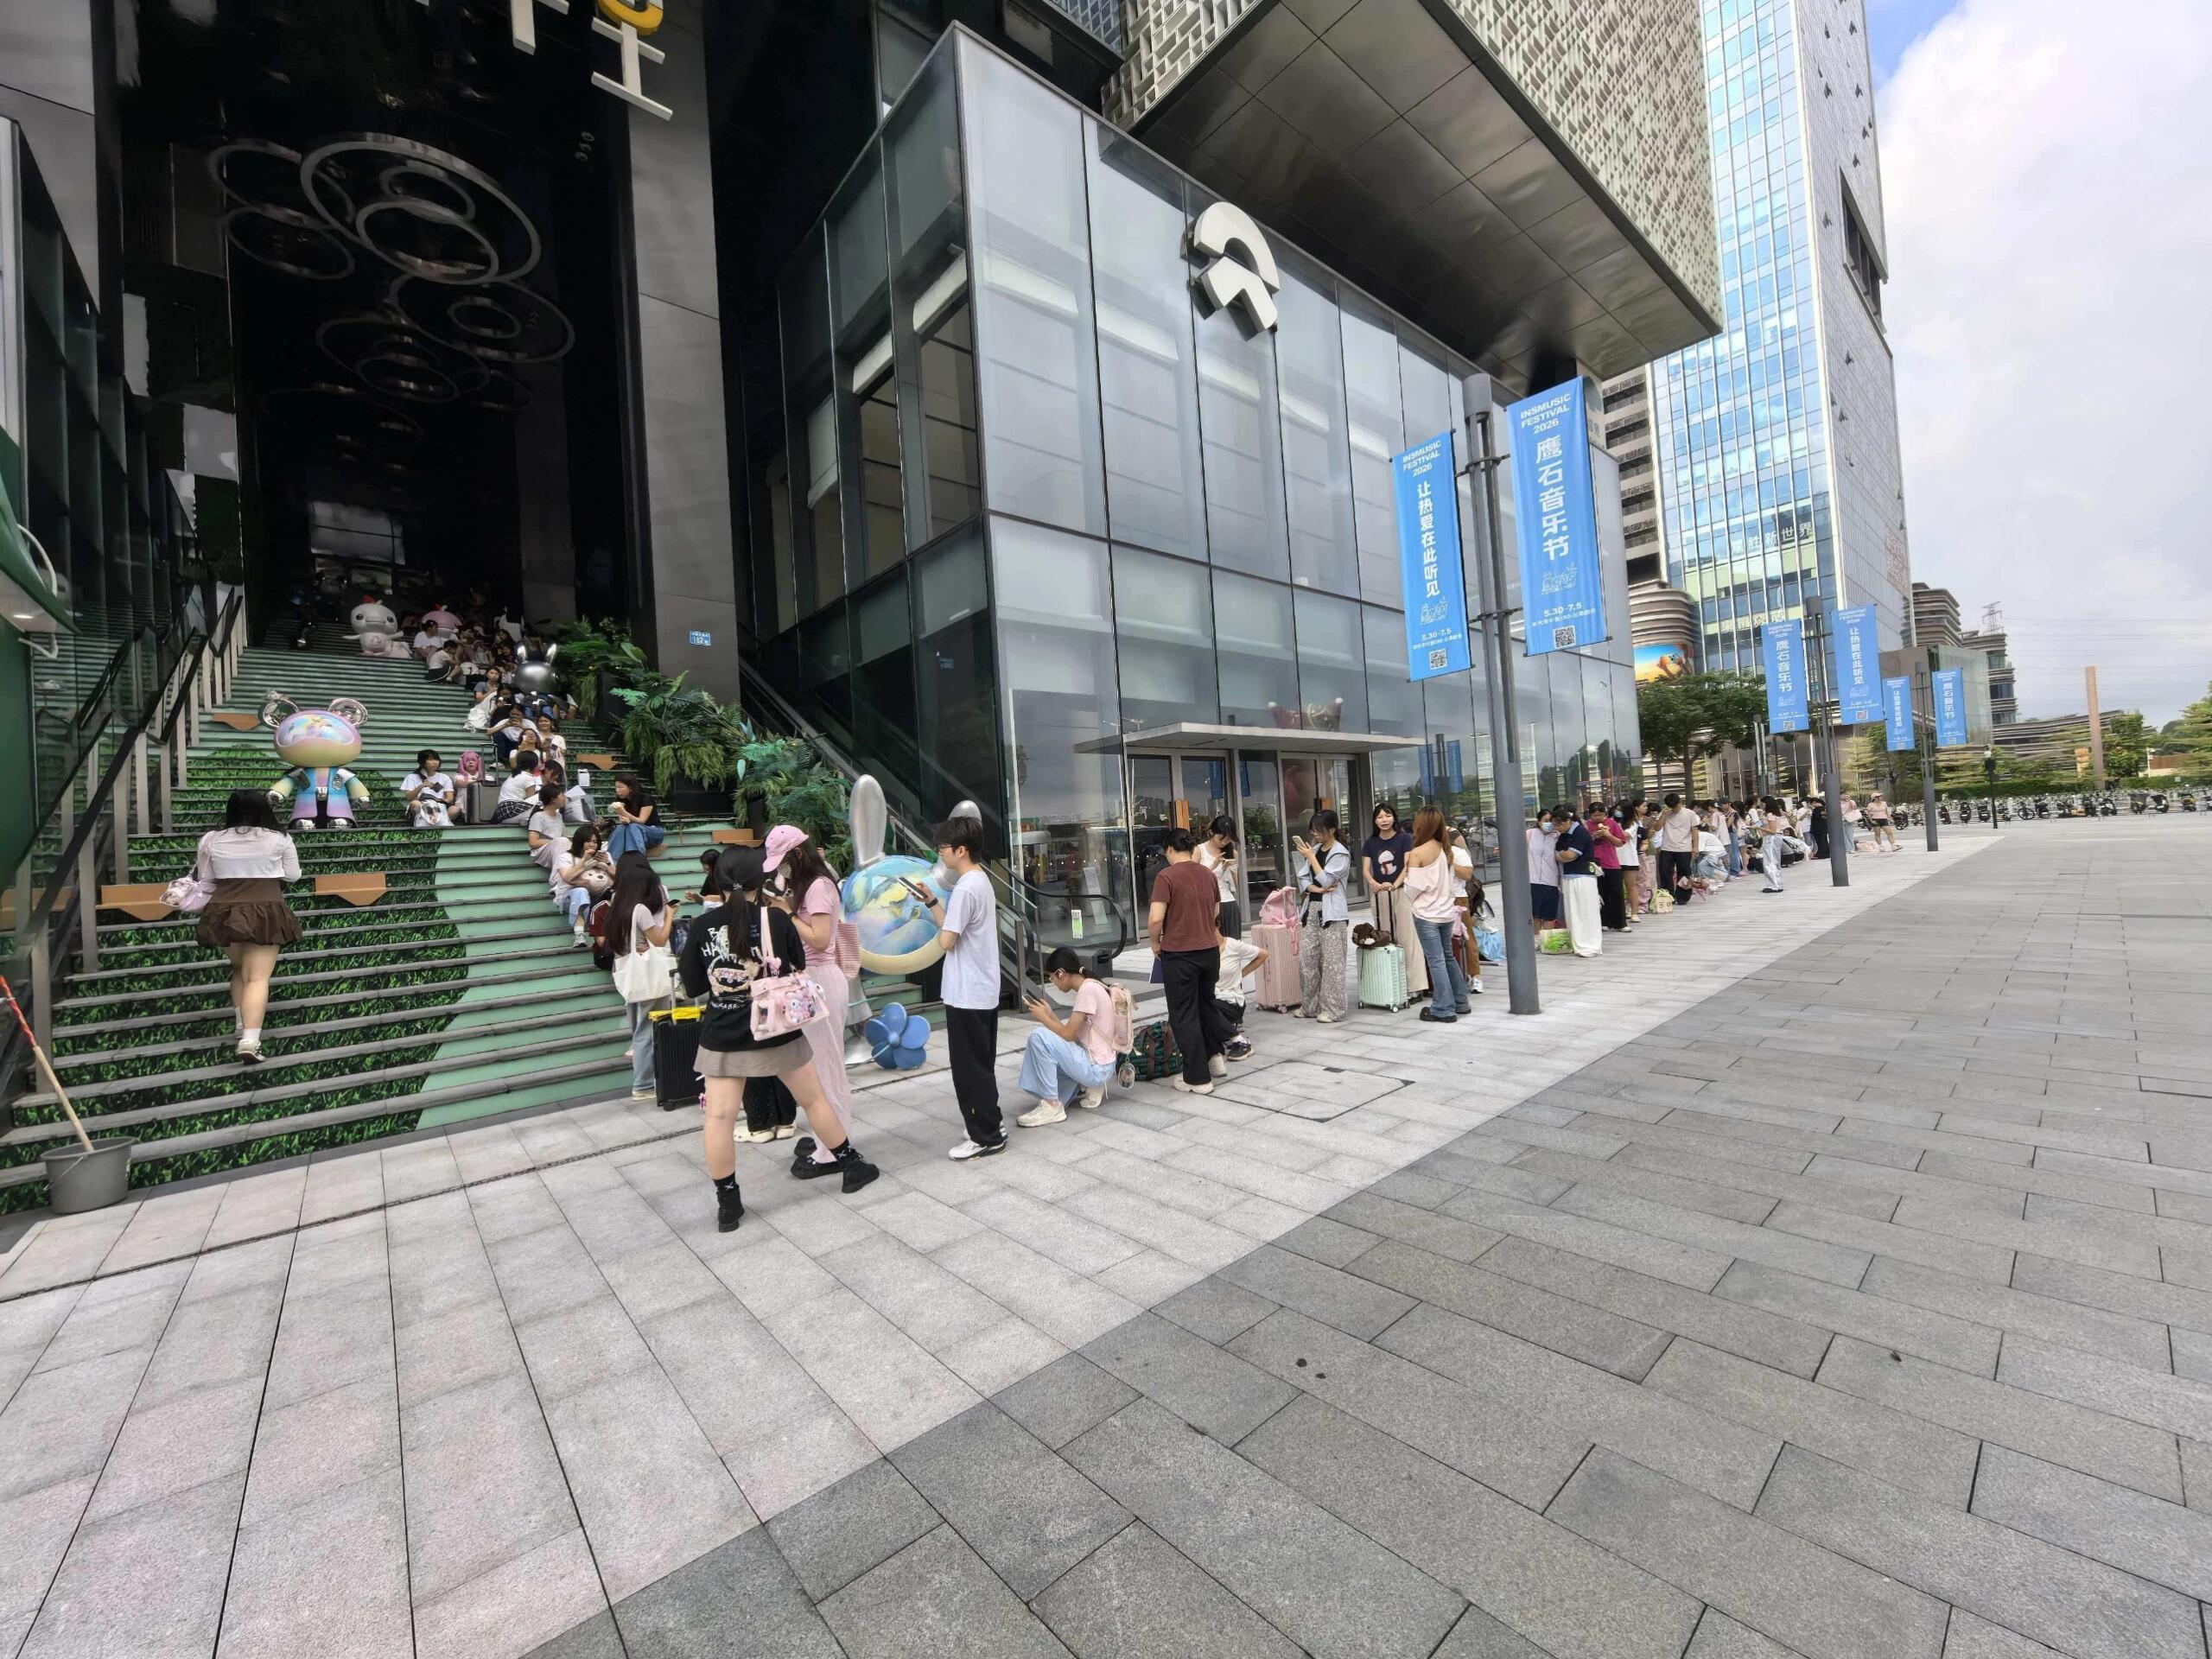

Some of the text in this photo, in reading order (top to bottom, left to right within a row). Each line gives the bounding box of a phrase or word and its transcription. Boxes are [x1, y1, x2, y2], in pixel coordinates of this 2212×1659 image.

[1521, 393, 1572, 419] INSMUSIC
[1522, 405, 1571, 429] FESTIVAL
[1534, 417, 1560, 434] 2026
[1402, 440, 1442, 463] INSMUSIC
[1403, 450, 1441, 472] FESTIVAL
[1535, 434, 1569, 561] 鹰石音乐节
[1417, 480, 1440, 598] 让热爱在此听见
